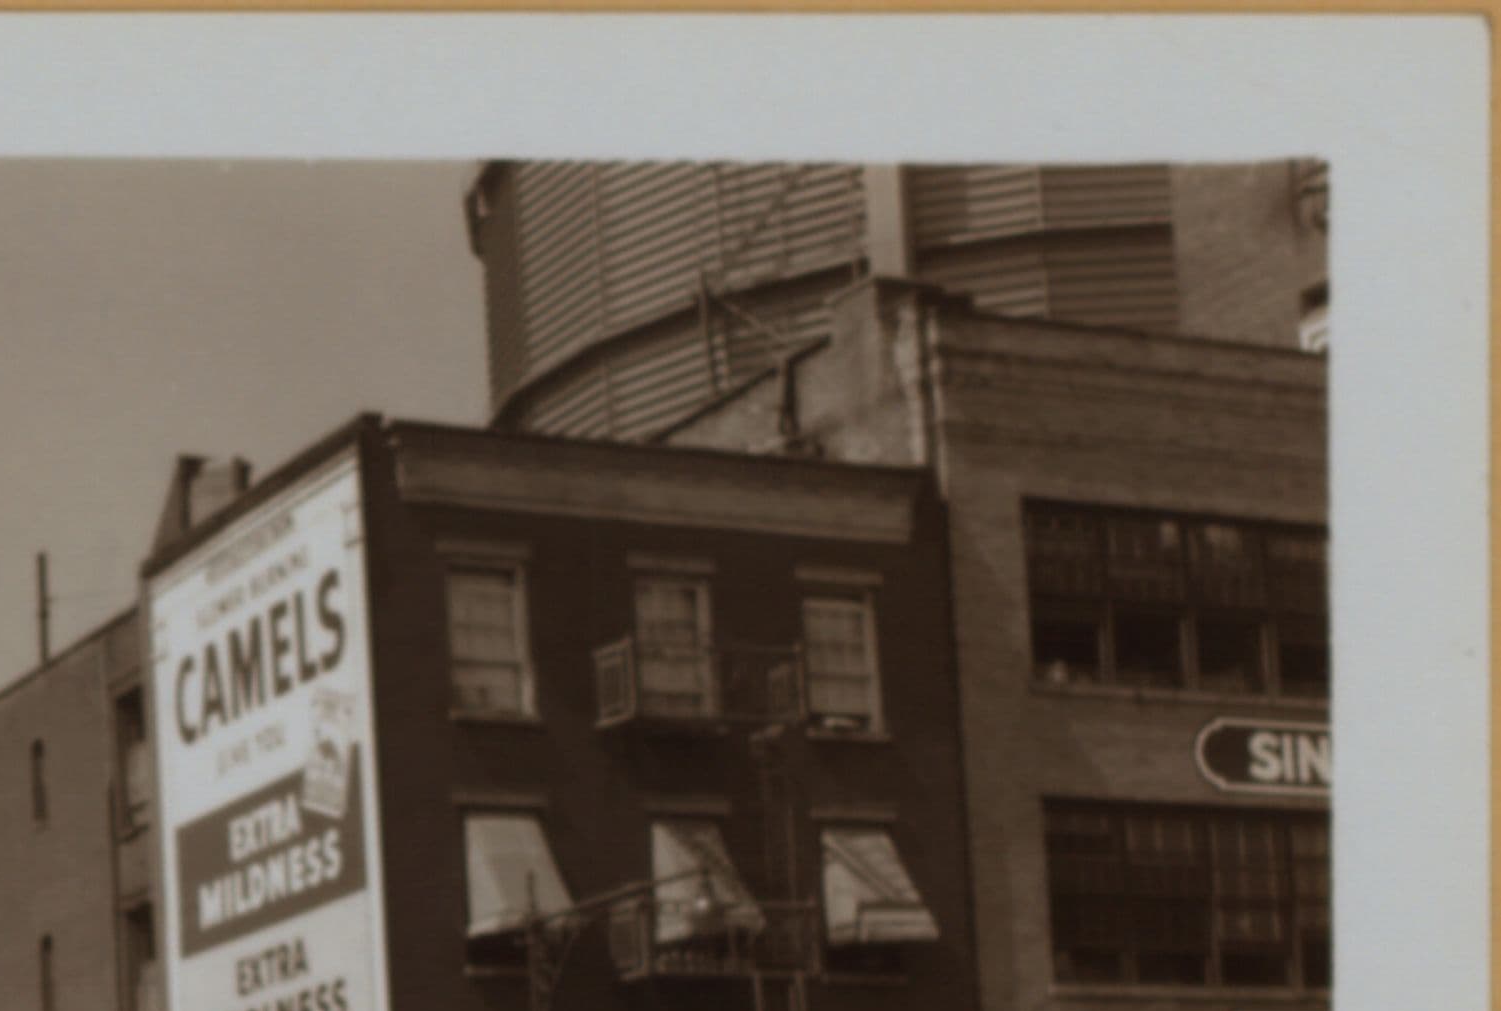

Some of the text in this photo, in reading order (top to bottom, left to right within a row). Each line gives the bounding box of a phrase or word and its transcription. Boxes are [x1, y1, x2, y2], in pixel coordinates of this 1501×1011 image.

[175, 567, 346, 745] CAMELS
[1248, 732, 1333, 783] SIN
[228, 793, 303, 863] EXTRA
[198, 827, 343, 932] MILDNESS
[235, 937, 310, 997] EXTRA
